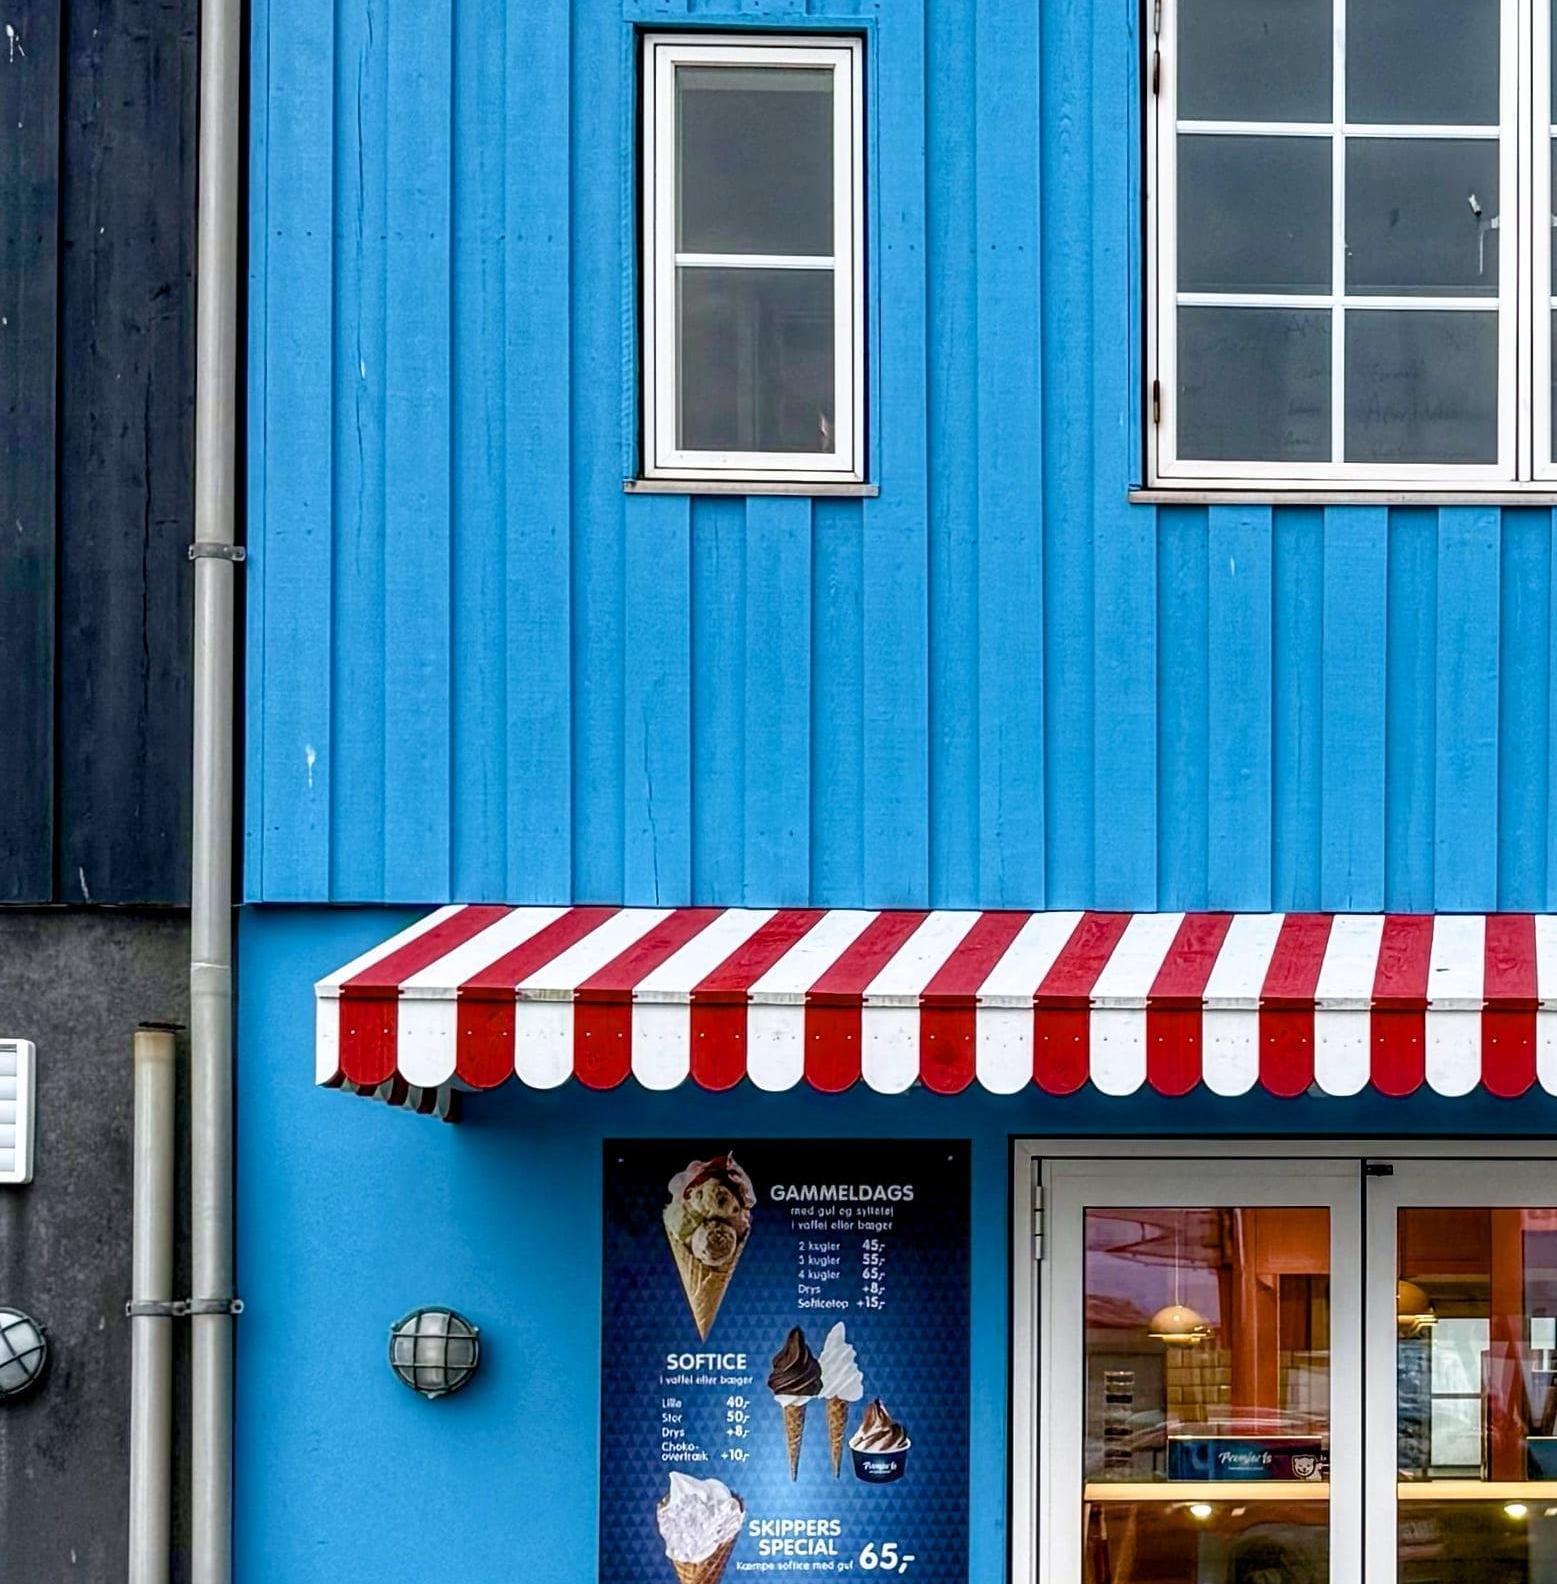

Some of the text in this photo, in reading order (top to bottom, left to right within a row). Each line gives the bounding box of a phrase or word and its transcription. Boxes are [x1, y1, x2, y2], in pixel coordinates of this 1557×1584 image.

[770, 1184, 914, 1201] GAMMELDAGS
[799, 1241, 805, 1251] 2
[862, 1239, 885, 1252] 45,-
[862, 1253, 885, 1266] 55,-
[798, 1269, 805, 1279] 4
[862, 1267, 885, 1281] 65,-
[798, 1282, 885, 1295] Drys +8,-
[856, 1296, 885, 1309] +15,-
[667, 1353, 747, 1371] SOFTICE
[726, 1396, 750, 1409] 40,-
[662, 1411, 750, 1424] Stor 50,-
[662, 1425, 750, 1439] Drys +8,-
[661, 1441, 699, 1452] Choko-
[721, 1448, 749, 1462] +10,-
[749, 1519, 842, 1537] SKIPPERS
[758, 1538, 838, 1556] SPECIAL
[859, 1542, 915, 1574] 65,-
